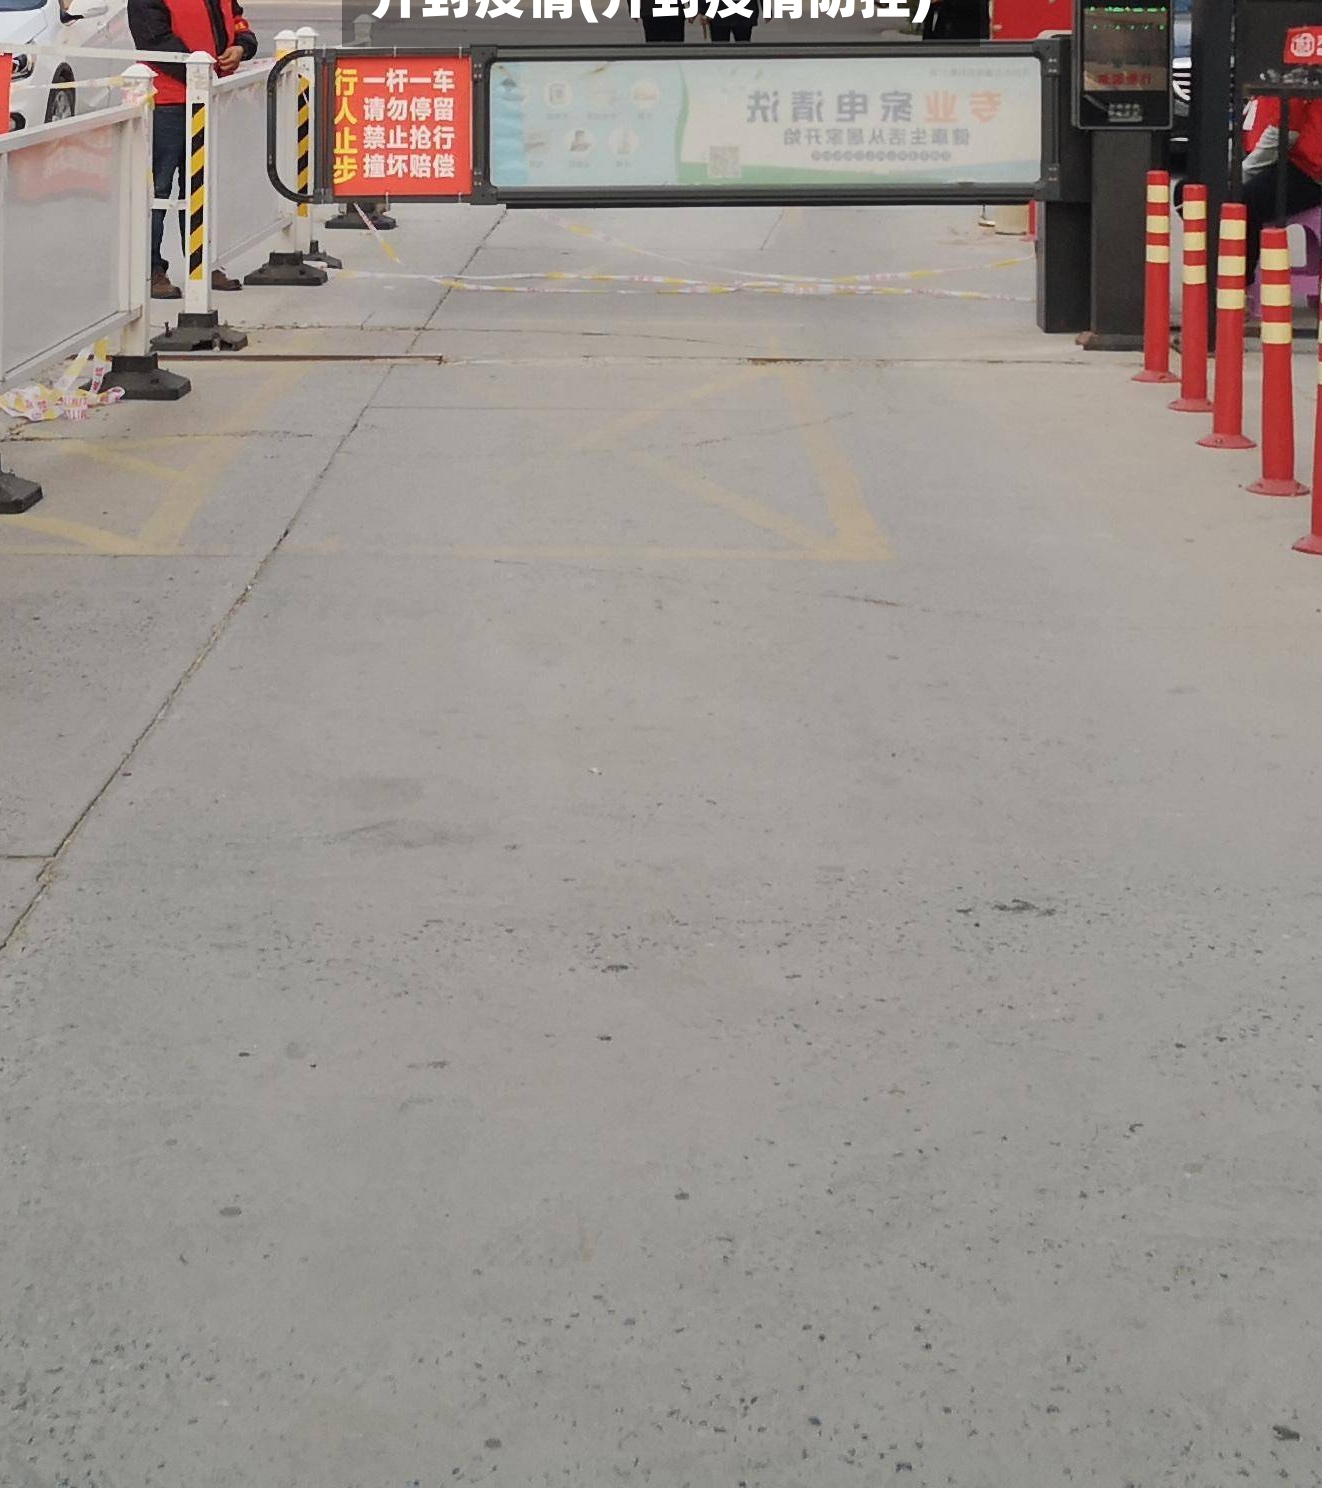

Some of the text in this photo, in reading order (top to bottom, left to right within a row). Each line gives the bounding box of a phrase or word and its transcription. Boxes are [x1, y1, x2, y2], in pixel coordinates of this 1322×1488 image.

[363, 68, 455, 93] 一杆一车
[363, 96, 454, 122] 请勿停留
[334, 68, 358, 184] 行人止步
[363, 125, 455, 150] 禁止抢行
[363, 153, 455, 179] 撞坏赔偿
